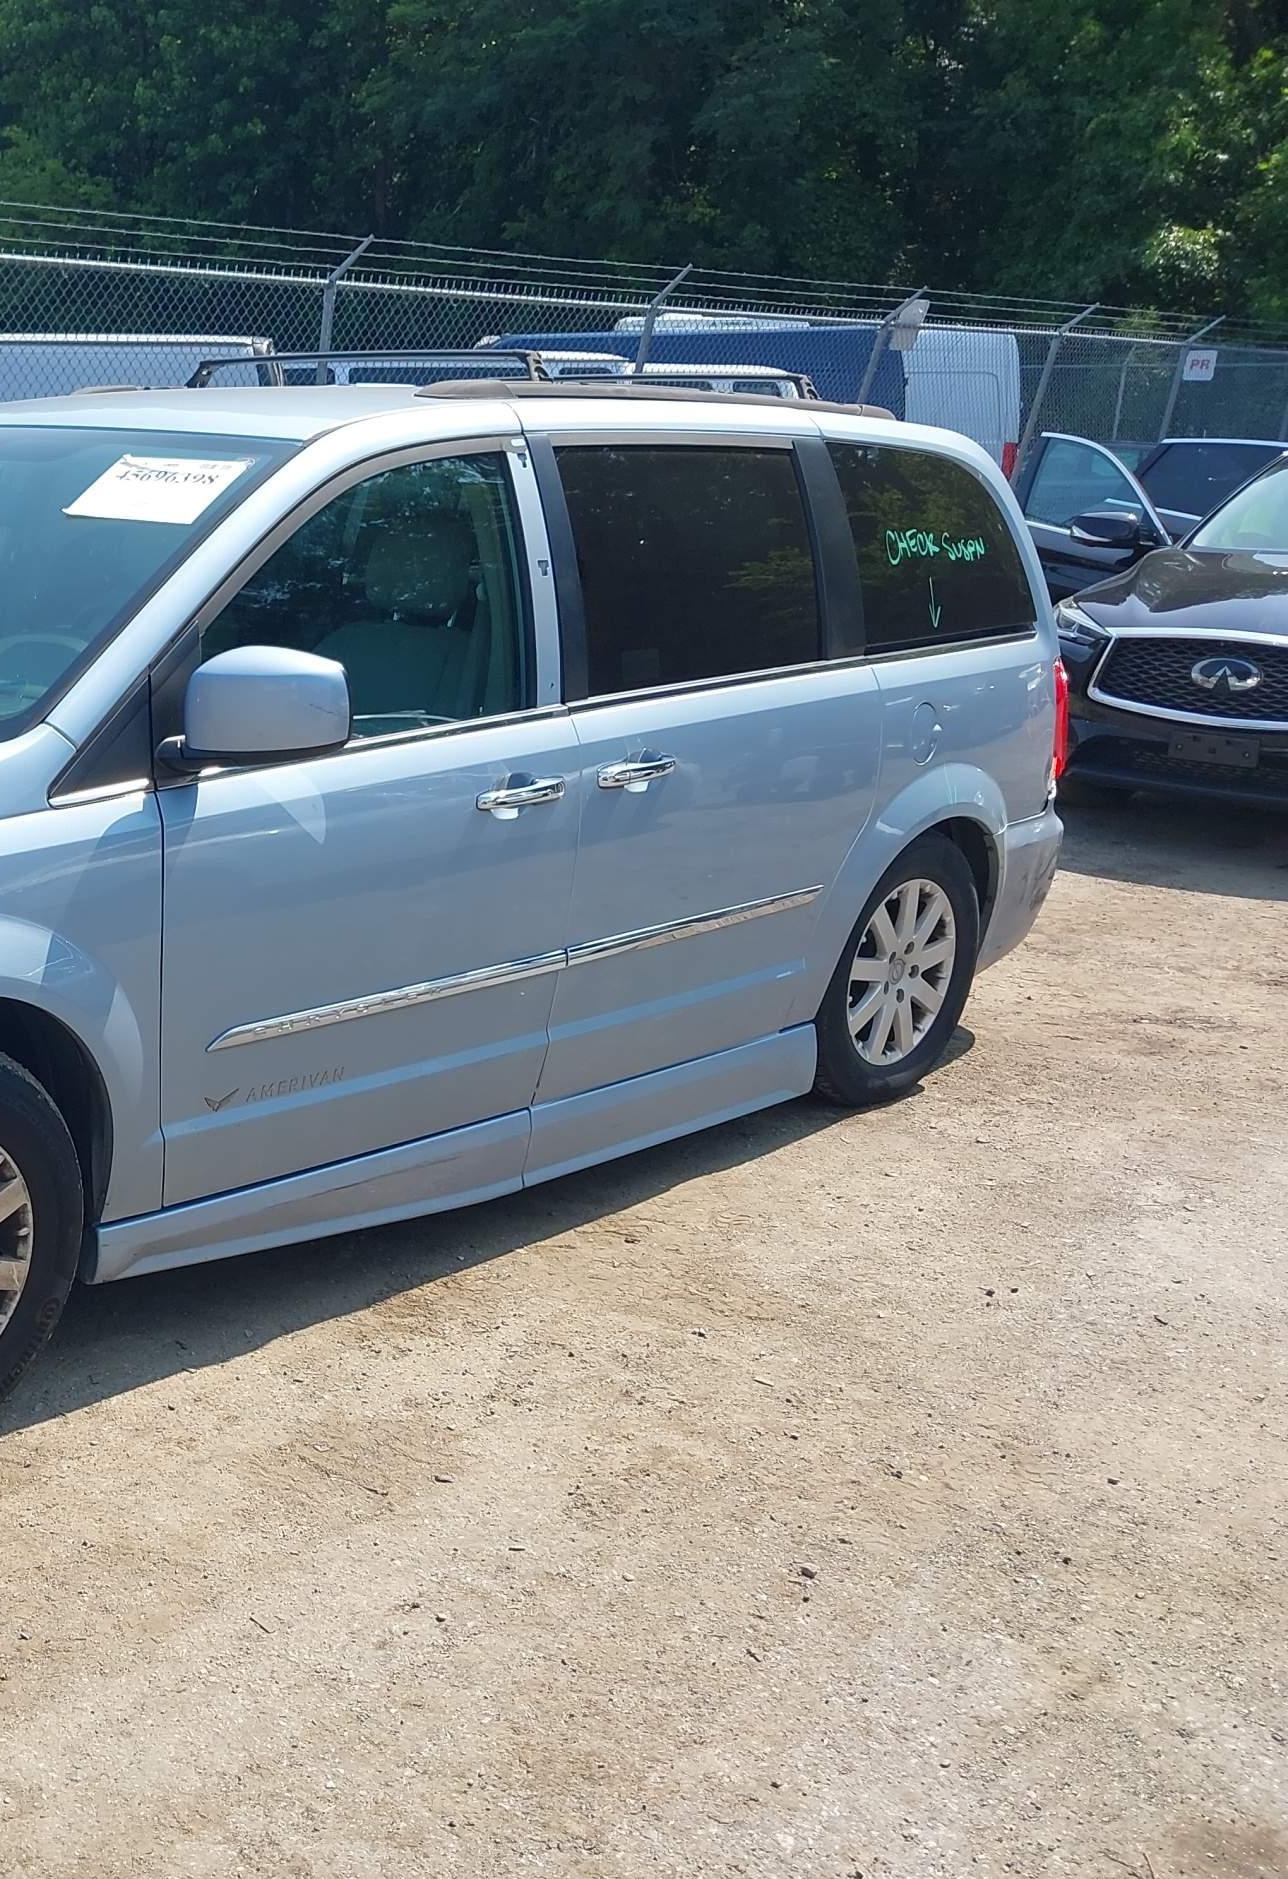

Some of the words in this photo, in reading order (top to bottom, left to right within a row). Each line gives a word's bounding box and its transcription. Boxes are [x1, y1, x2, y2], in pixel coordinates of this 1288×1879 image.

[1190, 359, 1210, 370] PR
[885, 528, 940, 566] CHECK
[253, 986, 442, 1035] CHRYSLER
[245, 1066, 346, 1103] AMERIVAN
